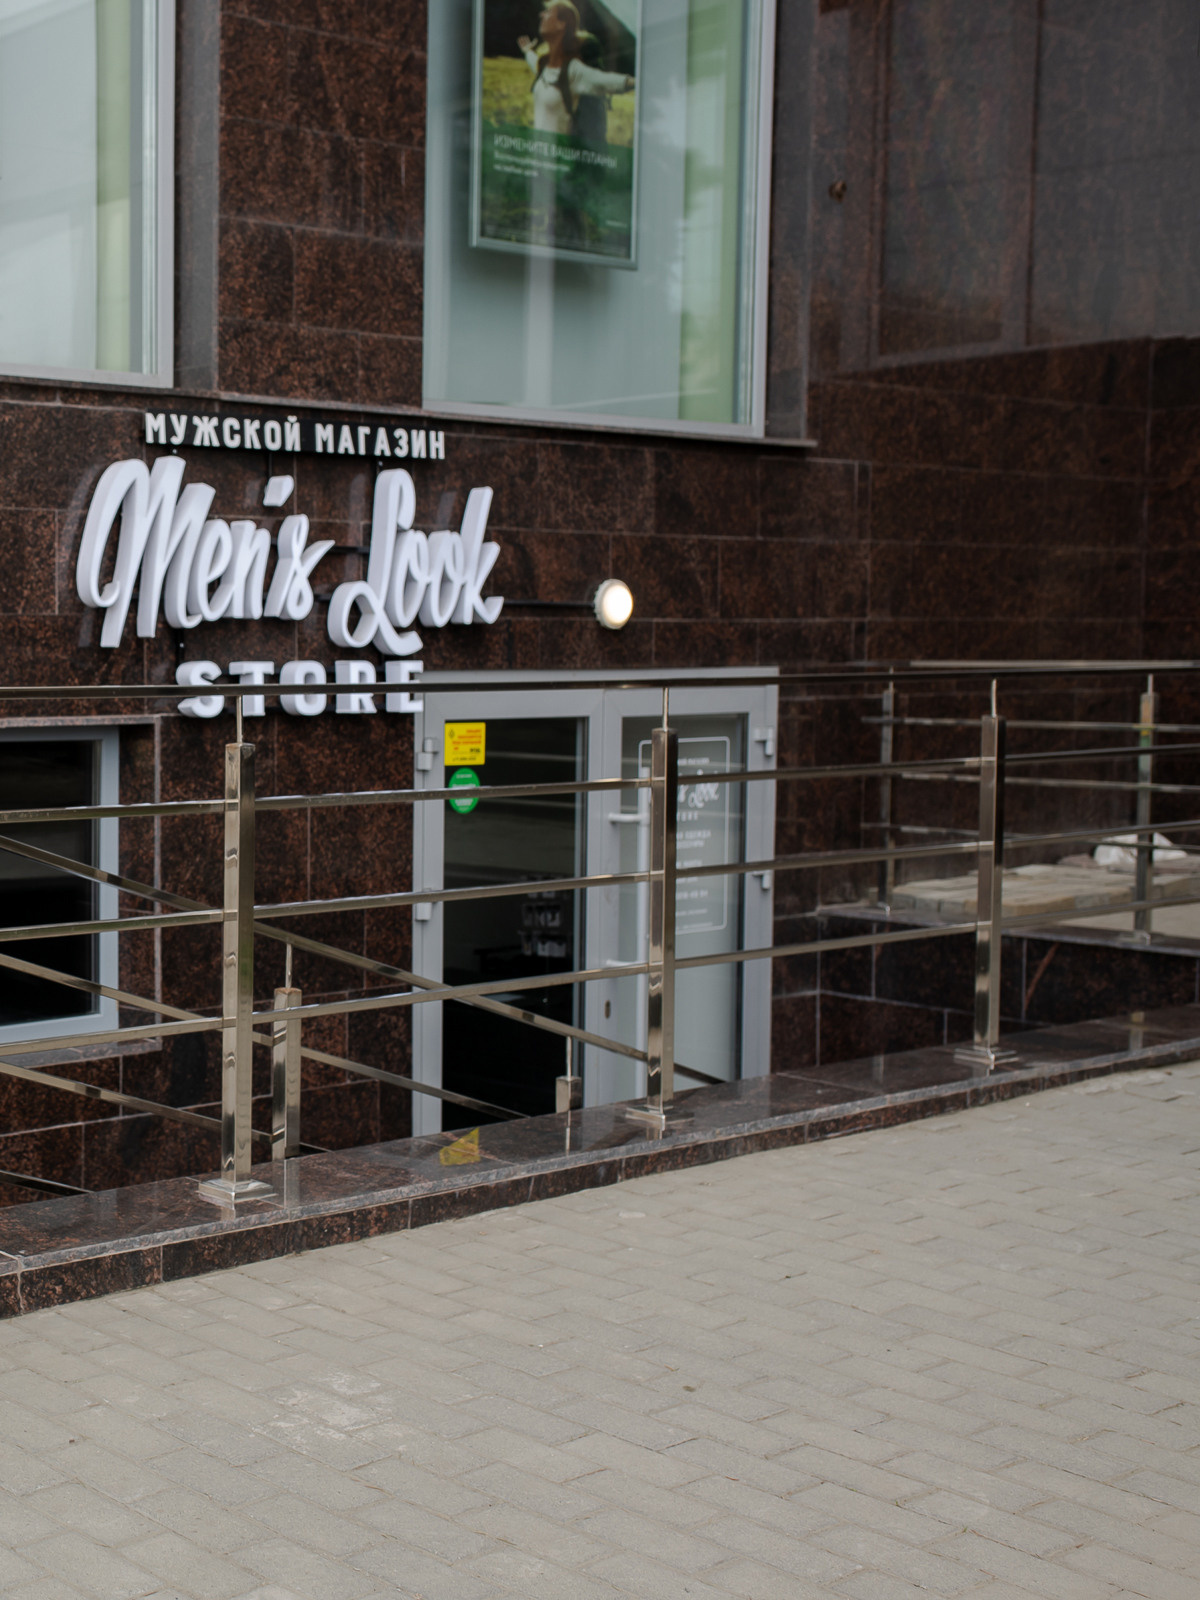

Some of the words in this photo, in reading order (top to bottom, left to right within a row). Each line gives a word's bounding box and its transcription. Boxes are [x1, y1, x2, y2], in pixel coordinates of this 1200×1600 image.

[494, 134, 549, 157] ИЗМЕНИТЕ
[145, 412, 300, 452] МУЖСКОЙ
[315, 423, 445, 460] МАГАЗИН
[76, 455, 336, 648] Men's
[327, 467, 505, 656] Look
[175, 659, 424, 718] STORE
